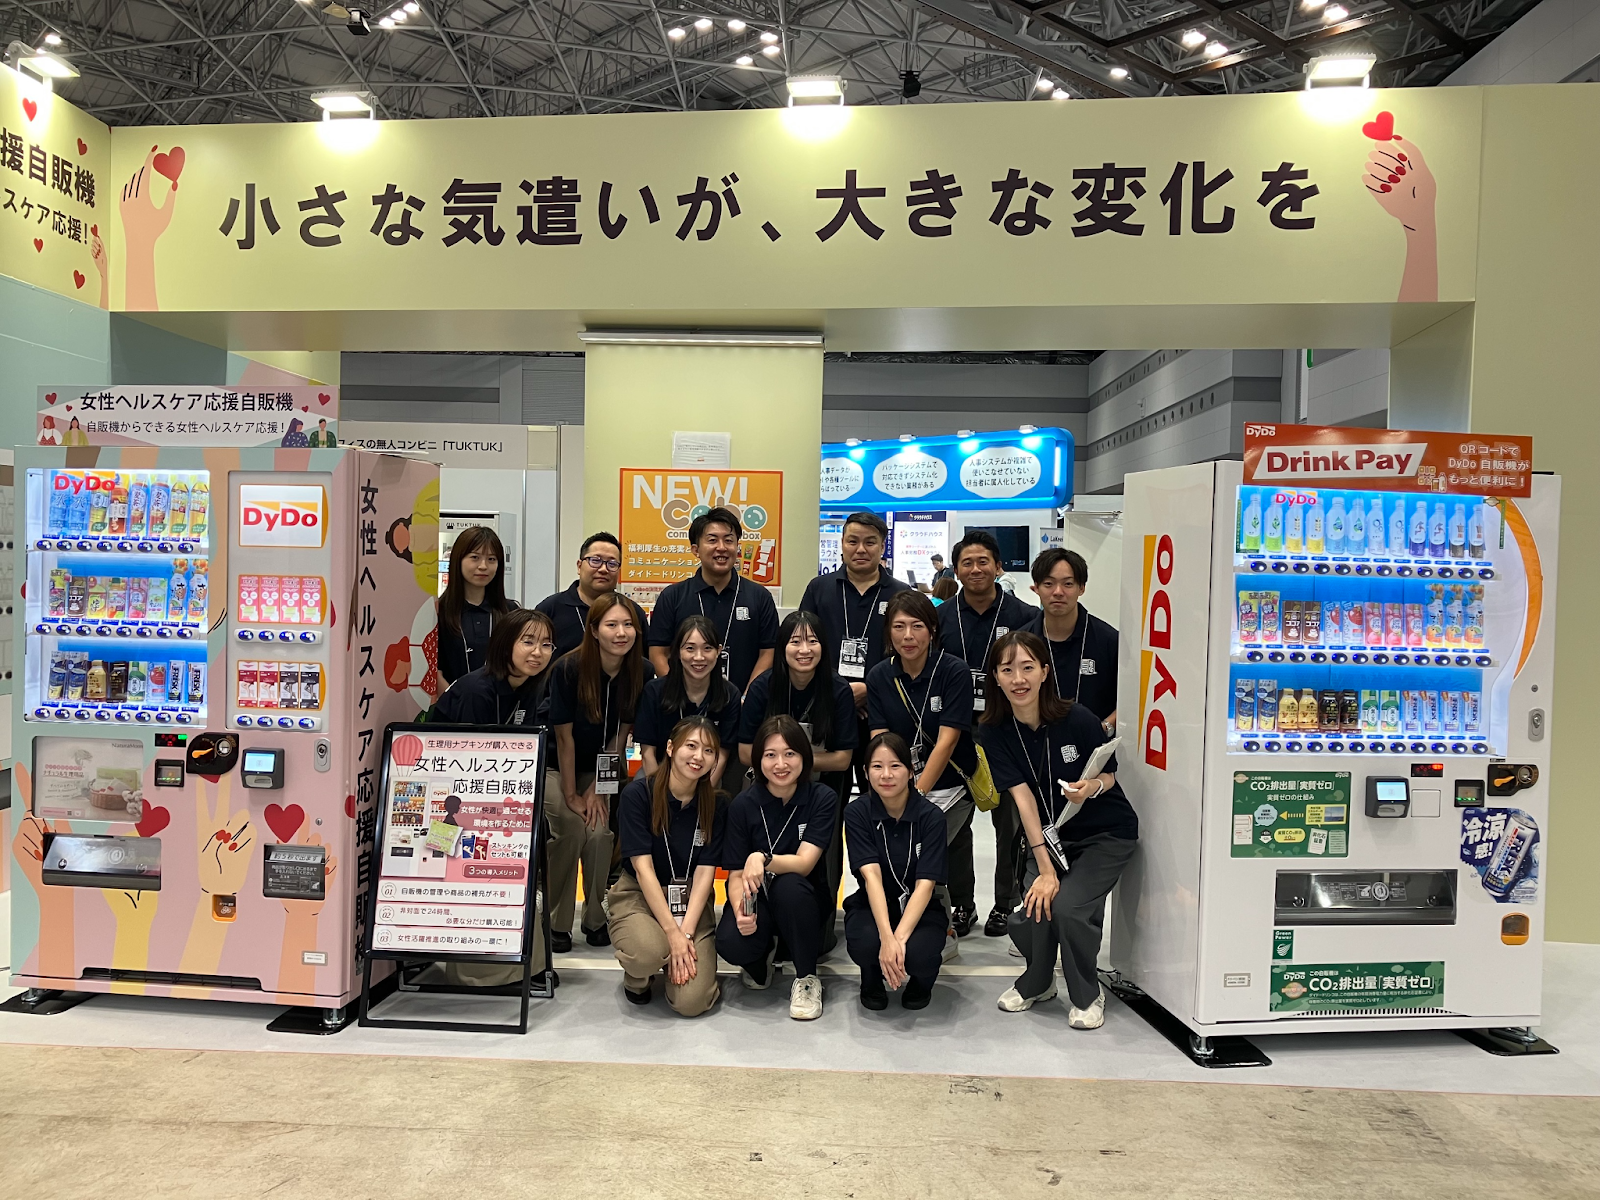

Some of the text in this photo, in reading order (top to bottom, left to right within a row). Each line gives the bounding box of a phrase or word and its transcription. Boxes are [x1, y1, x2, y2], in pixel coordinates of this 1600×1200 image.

[0, 127, 95, 208] 援自販機
[219, 161, 1320, 251] 小さな気遣いが、大きな変化を
[3, 188, 88, 245] スケア応援！
[80, 392, 294, 412] 女性ヘルスケア応援自販機
[86, 420, 285, 434] 自販機からできる女性ヘルスケア応援！
[1246, 425, 1276, 437] DyDo
[1460, 444, 1518, 456] QR コードで
[1267, 449, 1413, 475] Drink Pay
[1448, 458, 1529, 471] DyDo 自販機が
[54, 475, 116, 495] DyDo
[1449, 474, 1525, 487] もっと便利に！
[633, 474, 748, 511] NEW!
[1275, 491, 1317, 507] DyDo
[243, 506, 319, 532] DyDo
[1144, 534, 1177, 771] DyDo
[427, 740, 533, 750] 生理用ナプキンが購入できる
[413, 756, 534, 774] 女性ヘルスケア
[452, 779, 533, 796] 応援自販機
[1250, 780, 1335, 791] CO2排出量「実質ゼロ」
[473, 819, 531, 828] 環境を作るために
[401, 887, 511, 898] 自販機の管理や商品の補充が不要！
[382, 911, 391, 919] 02
[445, 918, 518, 927] 必要な分だけ購入可能！
[379, 935, 389, 943] 03
[397, 934, 508, 946] 女性活躍推進の取り組みの一環に！
[1284, 973, 1305, 981] DyDo
[1309, 975, 1435, 992] CO2排出量「実質ゼロ」
